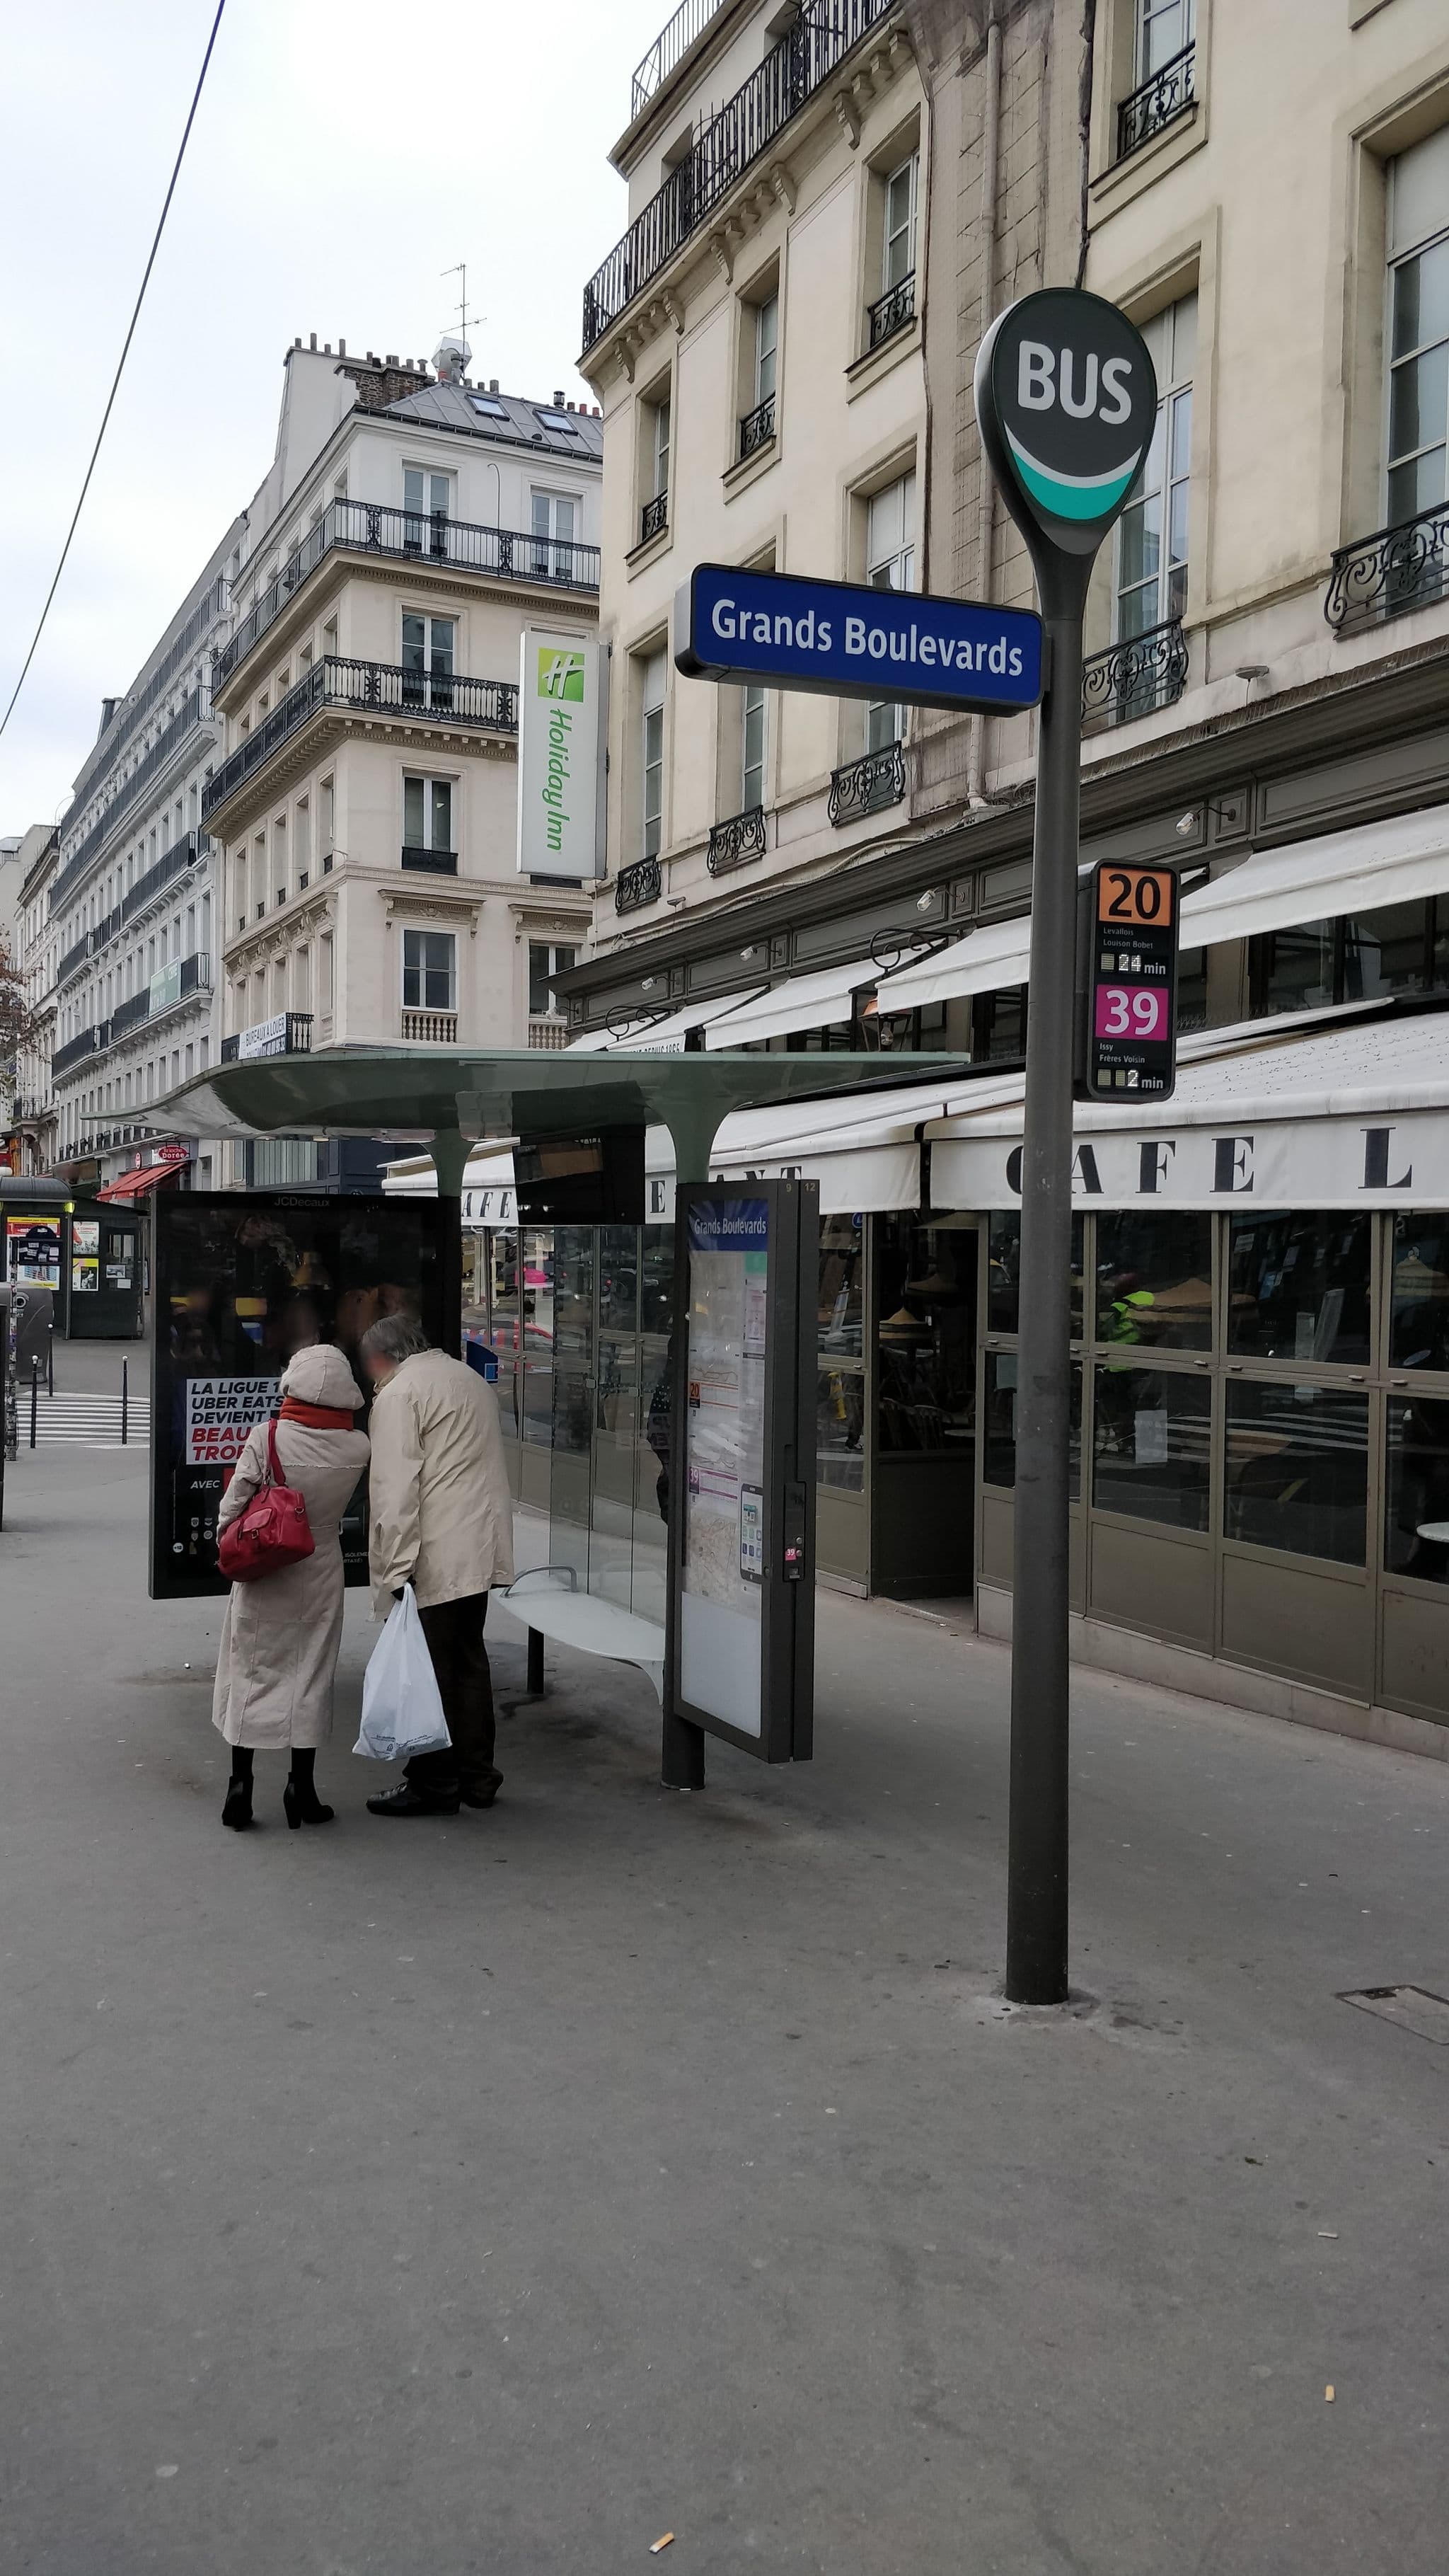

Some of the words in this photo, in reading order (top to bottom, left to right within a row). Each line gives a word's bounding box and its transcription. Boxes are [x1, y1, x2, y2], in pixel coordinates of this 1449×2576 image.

[1017, 340, 1132, 425] BUS
[711, 598, 833, 652] Grands
[844, 616, 1023, 677] Boulevards
[542, 708, 572, 807] Holiday
[546, 810, 570, 853] Inn
[1108, 873, 1160, 920] 20
[1104, 927, 1133, 936] Levallois
[1103, 938, 1131, 948] Louison
[1132, 941, 1153, 949] Bobet
[1119, 954, 1141, 972] 24
[1144, 962, 1166, 974] min
[1104, 990, 1159, 1035] 39
[1099, 1042, 1114, 1052] Issy
[1099, 1054, 1121, 1063] Frères
[1124, 1055, 1145, 1064] Voisin
[1127, 1069, 1138, 1087] 2
[1141, 1076, 1163, 1088] min
[785, 1183, 792, 1192] 9
[804, 1183, 816, 1192] 12
[274, 1196, 330, 1207] JCDecaux
[461, 1191, 512, 1219] AFE
[694, 1218, 720, 1234] Grands
[722, 1217, 766, 1234] Boulevards
[191, 1382, 214, 1395] LA
[218, 1381, 269, 1394] LIGUE
[691, 1383, 700, 1398] 20
[192, 1397, 238, 1409] UBER
[243, 1396, 284, 1408] EATS
[191, 1410, 267, 1425] DEVIENT
[690, 1467, 699, 1483] 39
[190, 1480, 220, 1489] AVEC
